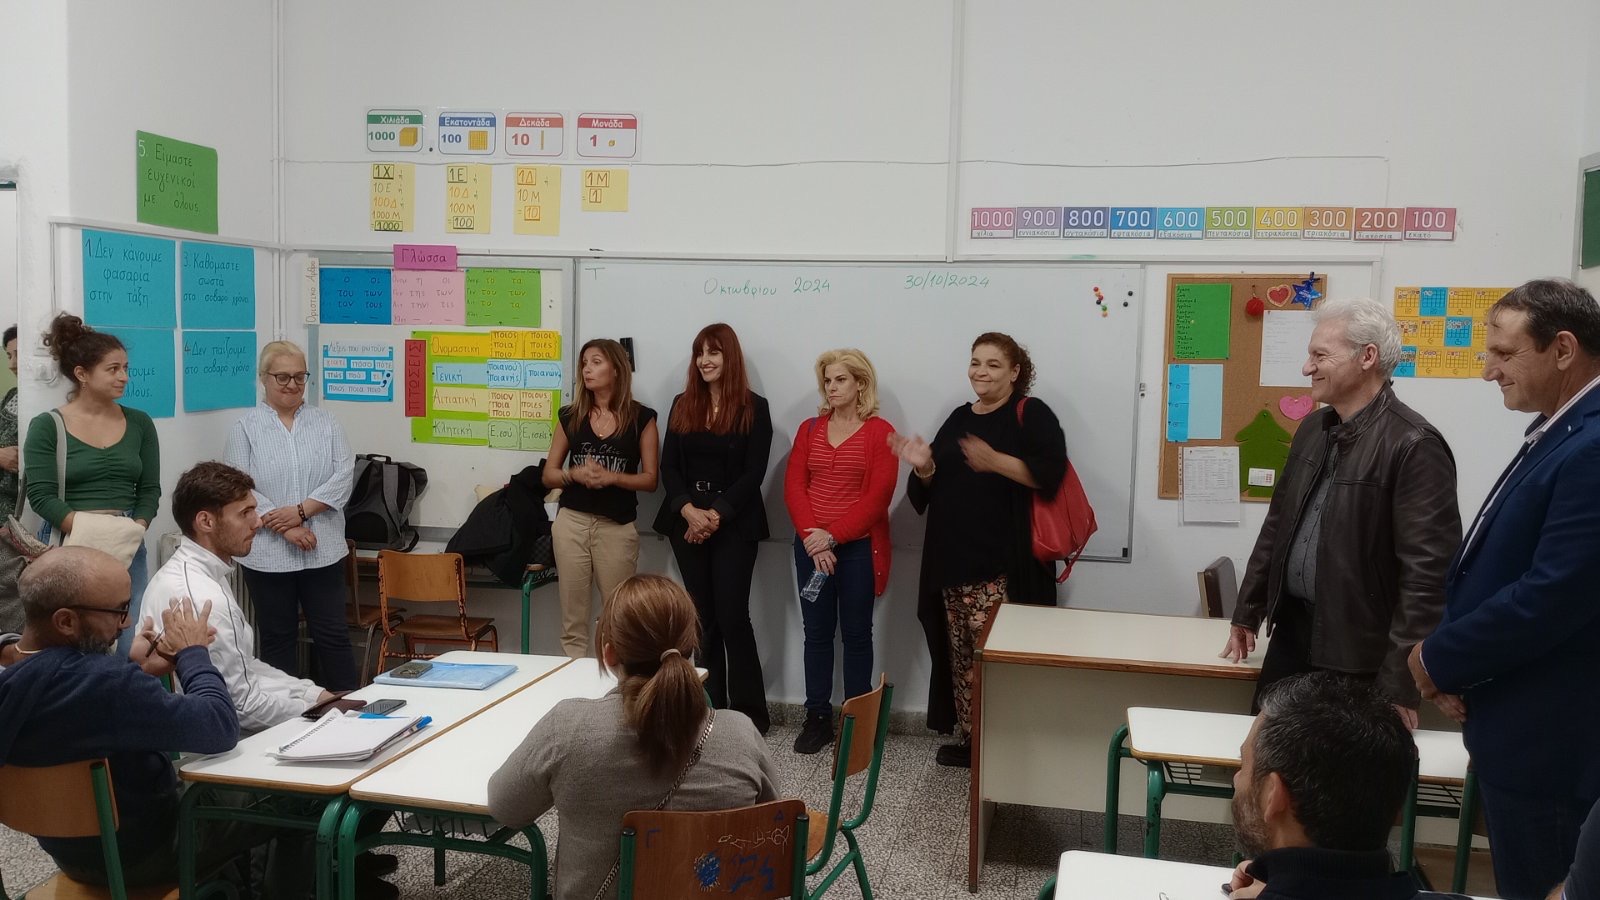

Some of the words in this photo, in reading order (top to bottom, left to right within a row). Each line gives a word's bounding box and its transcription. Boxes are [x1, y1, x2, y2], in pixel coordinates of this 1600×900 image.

[380, 115, 410, 124] Χιλιάδα
[444, 117, 491, 127] Εκατοντάδα
[519, 118, 550, 127] Δεκάδα
[591, 118, 623, 128] Μονάδα
[368, 131, 396, 141] 1000
[441, 134, 462, 143] 100
[511, 133, 530, 146] 10
[589, 134, 598, 147] 1
[155, 143, 193, 167] Είμαστε
[147, 168, 196, 193] ευγενικοί
[143, 193, 156, 208] με
[972, 210, 1014, 227] 1000
[1022, 210, 1056, 226] 900
[1068, 210, 1104, 227] 800
[1116, 210, 1151, 227] 700
[1163, 211, 1198, 227] 600
[1212, 210, 1247, 227] 500
[1260, 210, 1297, 227] 400
[1309, 210, 1346, 227] 300
[1361, 211, 1398, 228] 200
[1413, 211, 1446, 228] 100
[95, 236, 114, 259] Δεν
[122, 244, 162, 264] κάνουμε
[401, 248, 448, 264] Γλώσσα
[193, 252, 240, 274] Καθόμαστε
[103, 265, 150, 284] φασαρία
[903, 270, 990, 290] 30/10/2024
[793, 276, 831, 293] 2024
[89, 288, 113, 305] στην
[128, 288, 149, 309] τάξη
[183, 293, 196, 301] στο
[192, 340, 207, 356] Δεν
[431, 336, 480, 354] Ονομαστική
[493, 341, 514, 349] ποια
[530, 351, 552, 359] ποια
[184, 366, 199, 375] στο
[408, 343, 422, 412] ΠΤΩΣΕΙΣ
[435, 365, 463, 384] Γενική
[433, 390, 477, 407] Αιτιατική
[491, 392, 514, 401] ποιον
[492, 401, 511, 409] ποια
[521, 410, 542, 418] ποια
[433, 421, 473, 438] Κλητική
